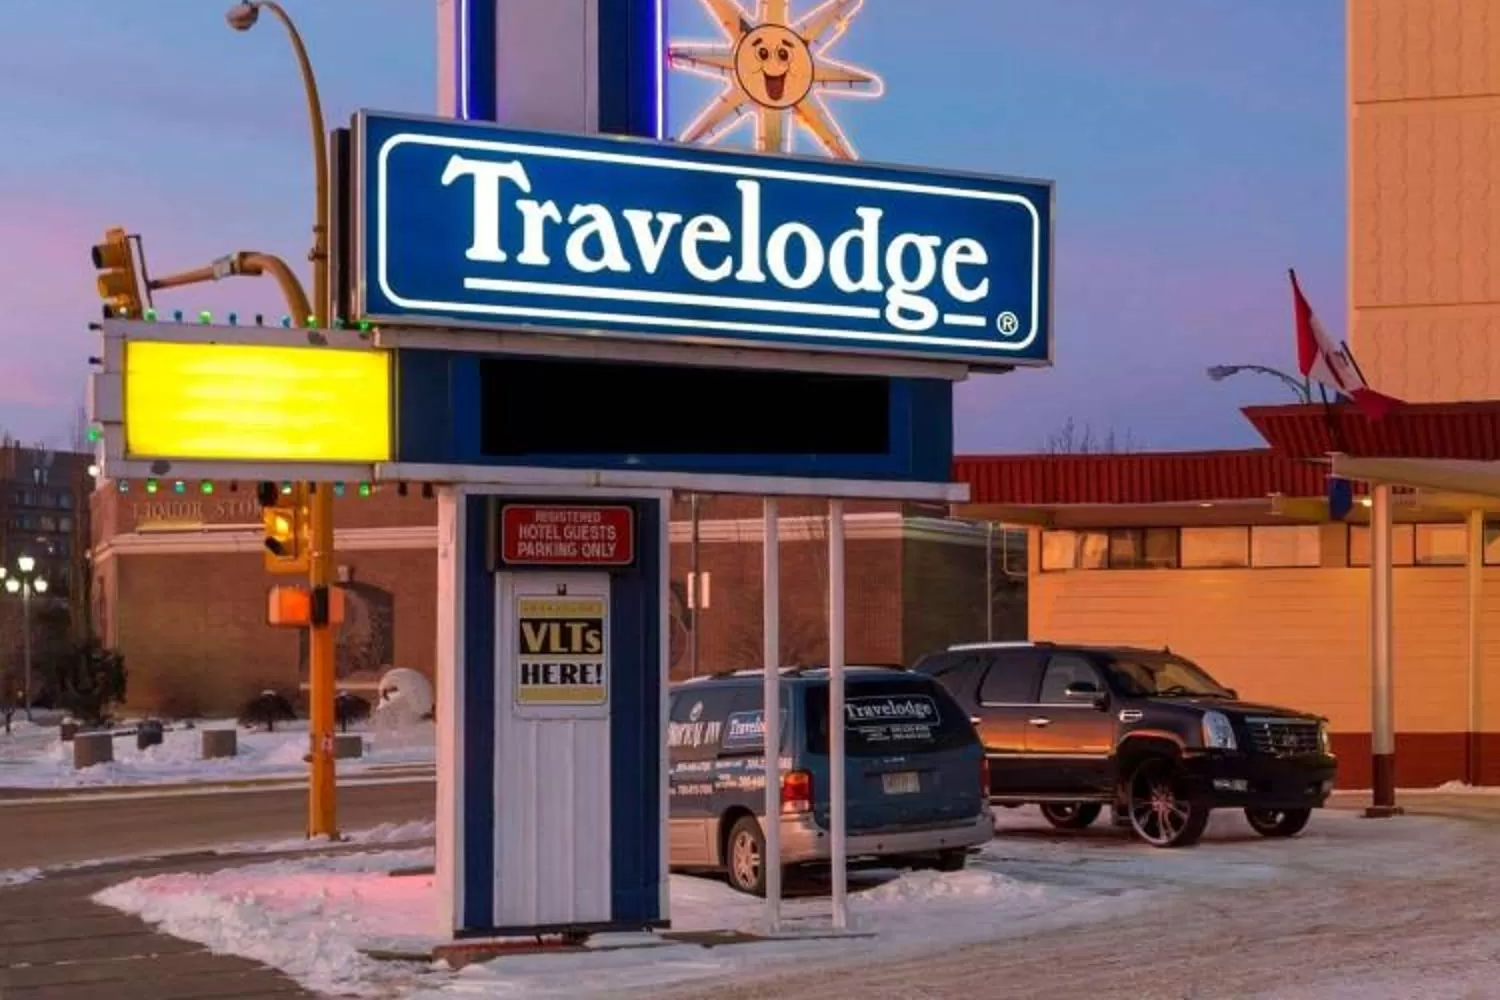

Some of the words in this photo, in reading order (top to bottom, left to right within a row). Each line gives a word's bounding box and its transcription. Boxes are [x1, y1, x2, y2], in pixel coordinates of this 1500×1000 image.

[441, 154, 990, 331] Travelodge
[131, 502, 204, 520] LIQUOR
[535, 510, 602, 523] REGISTERED
[519, 523, 562, 540] HOTEL
[563, 525, 617, 541] GUESTS
[517, 541, 578, 558] PARKING
[581, 542, 617, 558] ONLY
[521, 620, 602, 653] VLTs
[521, 663, 603, 685] HERE!
[844, 699, 933, 719] Travelodge
